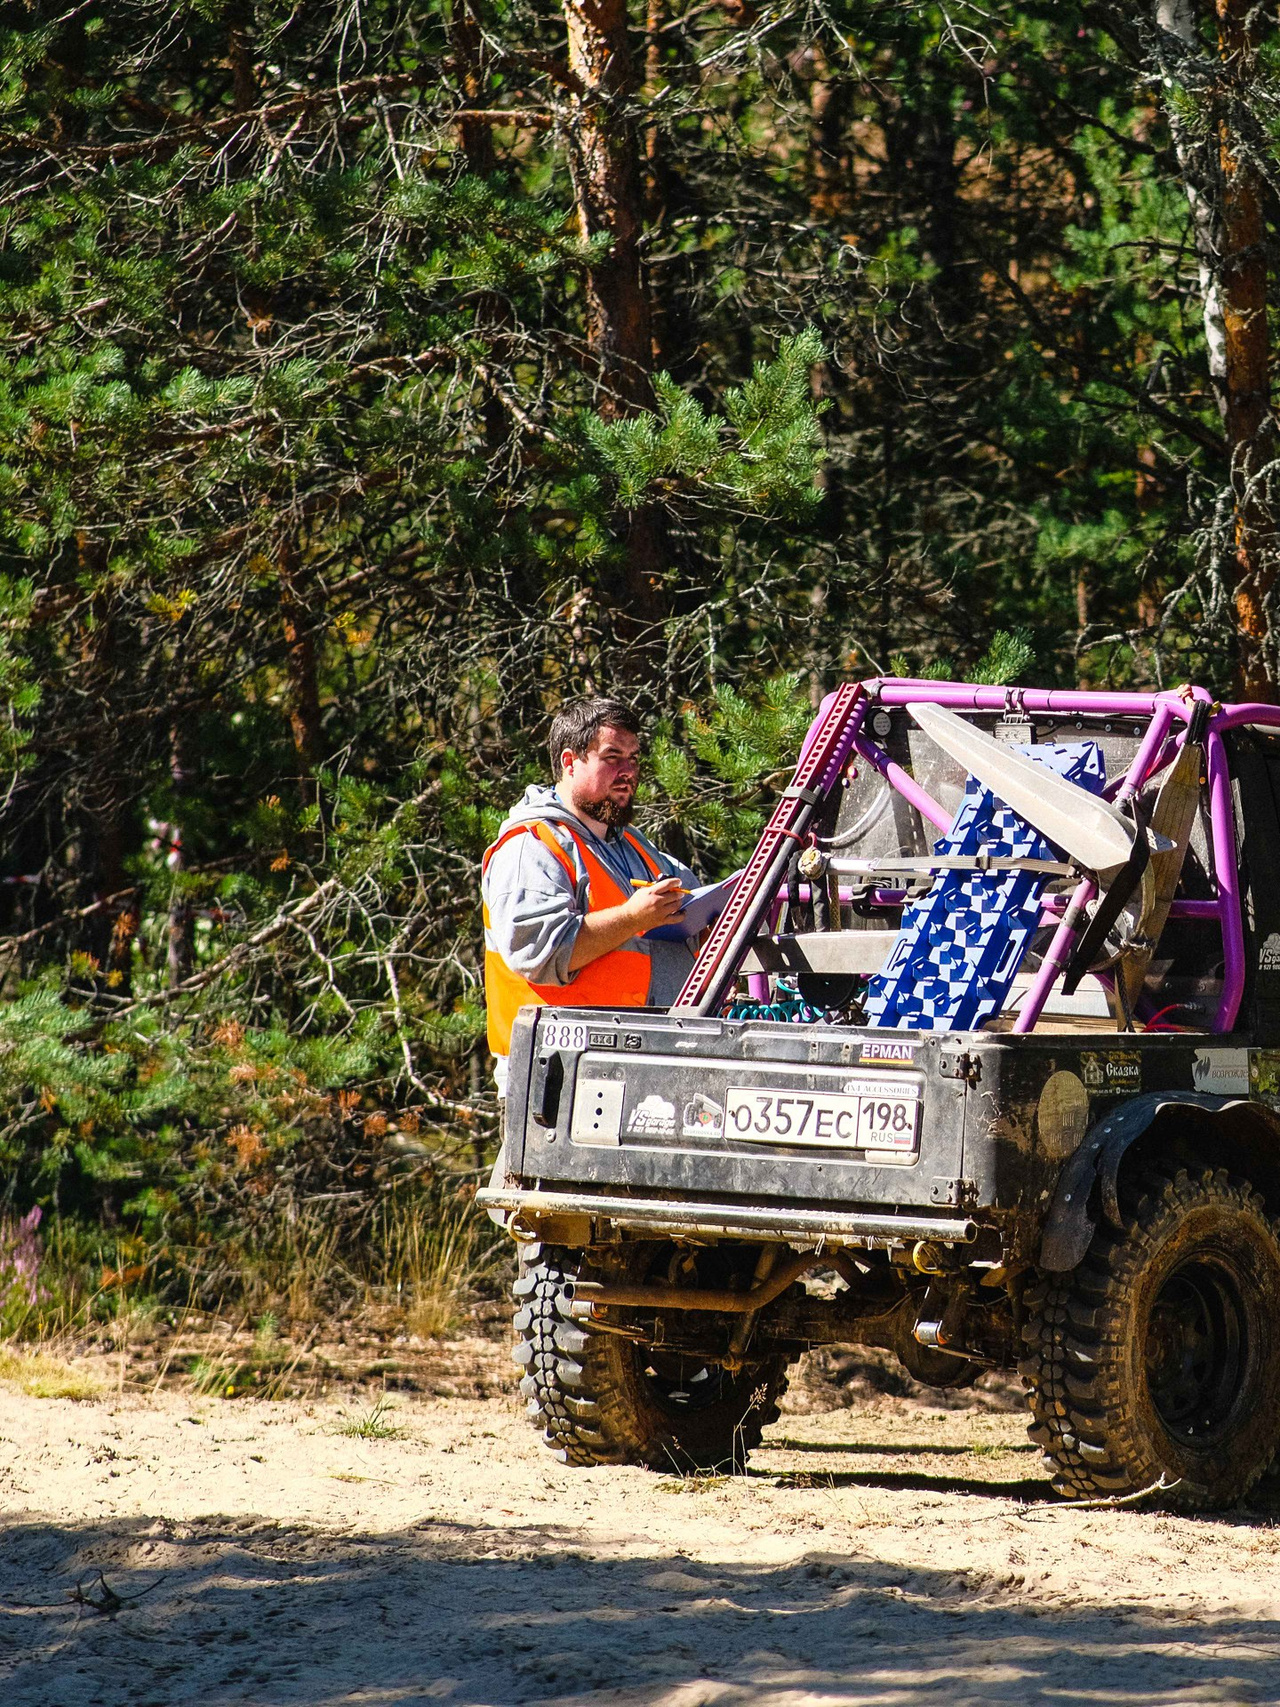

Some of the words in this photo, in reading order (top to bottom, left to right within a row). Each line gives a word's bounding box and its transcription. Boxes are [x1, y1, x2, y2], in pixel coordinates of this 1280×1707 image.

[545, 1025, 583, 1048] 888
[862, 1045, 912, 1059] EPMAN
[1106, 1062, 1139, 1077] Сказка
[863, 1101, 908, 1131] 198
[870, 1131, 893, 1143] RUS
